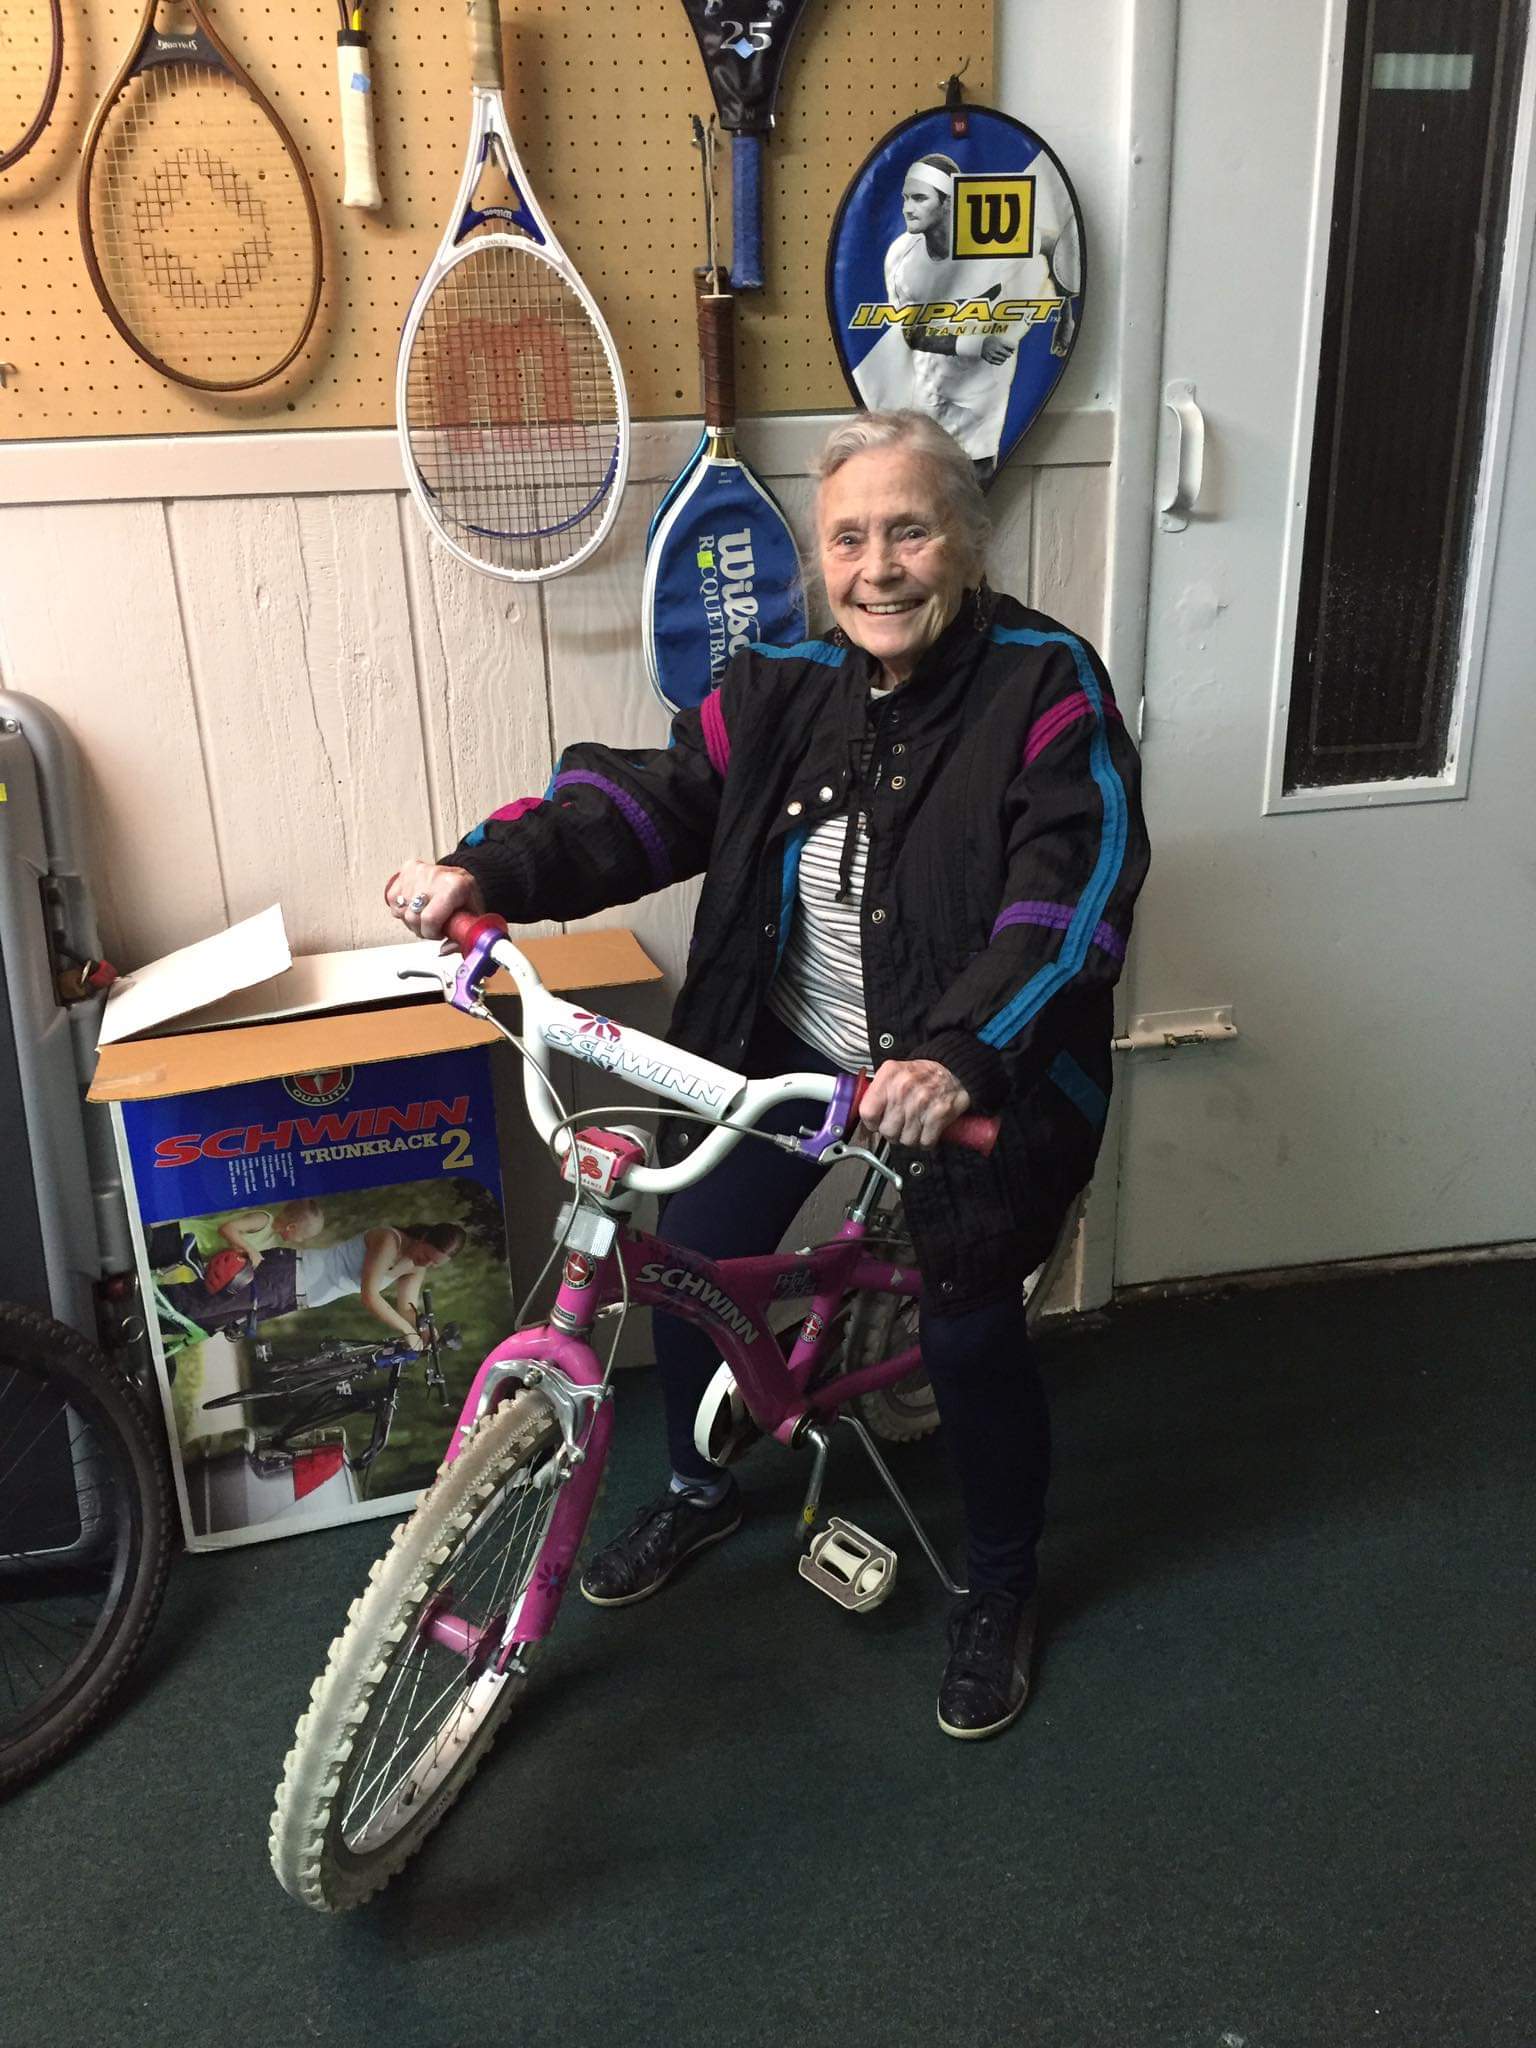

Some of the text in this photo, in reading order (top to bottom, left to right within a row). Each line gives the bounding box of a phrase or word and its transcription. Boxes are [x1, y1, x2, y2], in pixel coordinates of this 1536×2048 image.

[720, 20, 772, 51] 25
[966, 193, 1021, 244] W
[849, 297, 1065, 329] IMPACT
[698, 535, 728, 691] RCQUETBALL
[717, 527, 761, 658] Wilso
[292, 1083, 346, 1103] QUALITY
[544, 1023, 726, 1107] SCHWINN
[154, 1096, 470, 1168] SCHWINN
[300, 1128, 475, 1170] TRUNKRACK 2
[635, 1263, 760, 1345] SCHWINN
